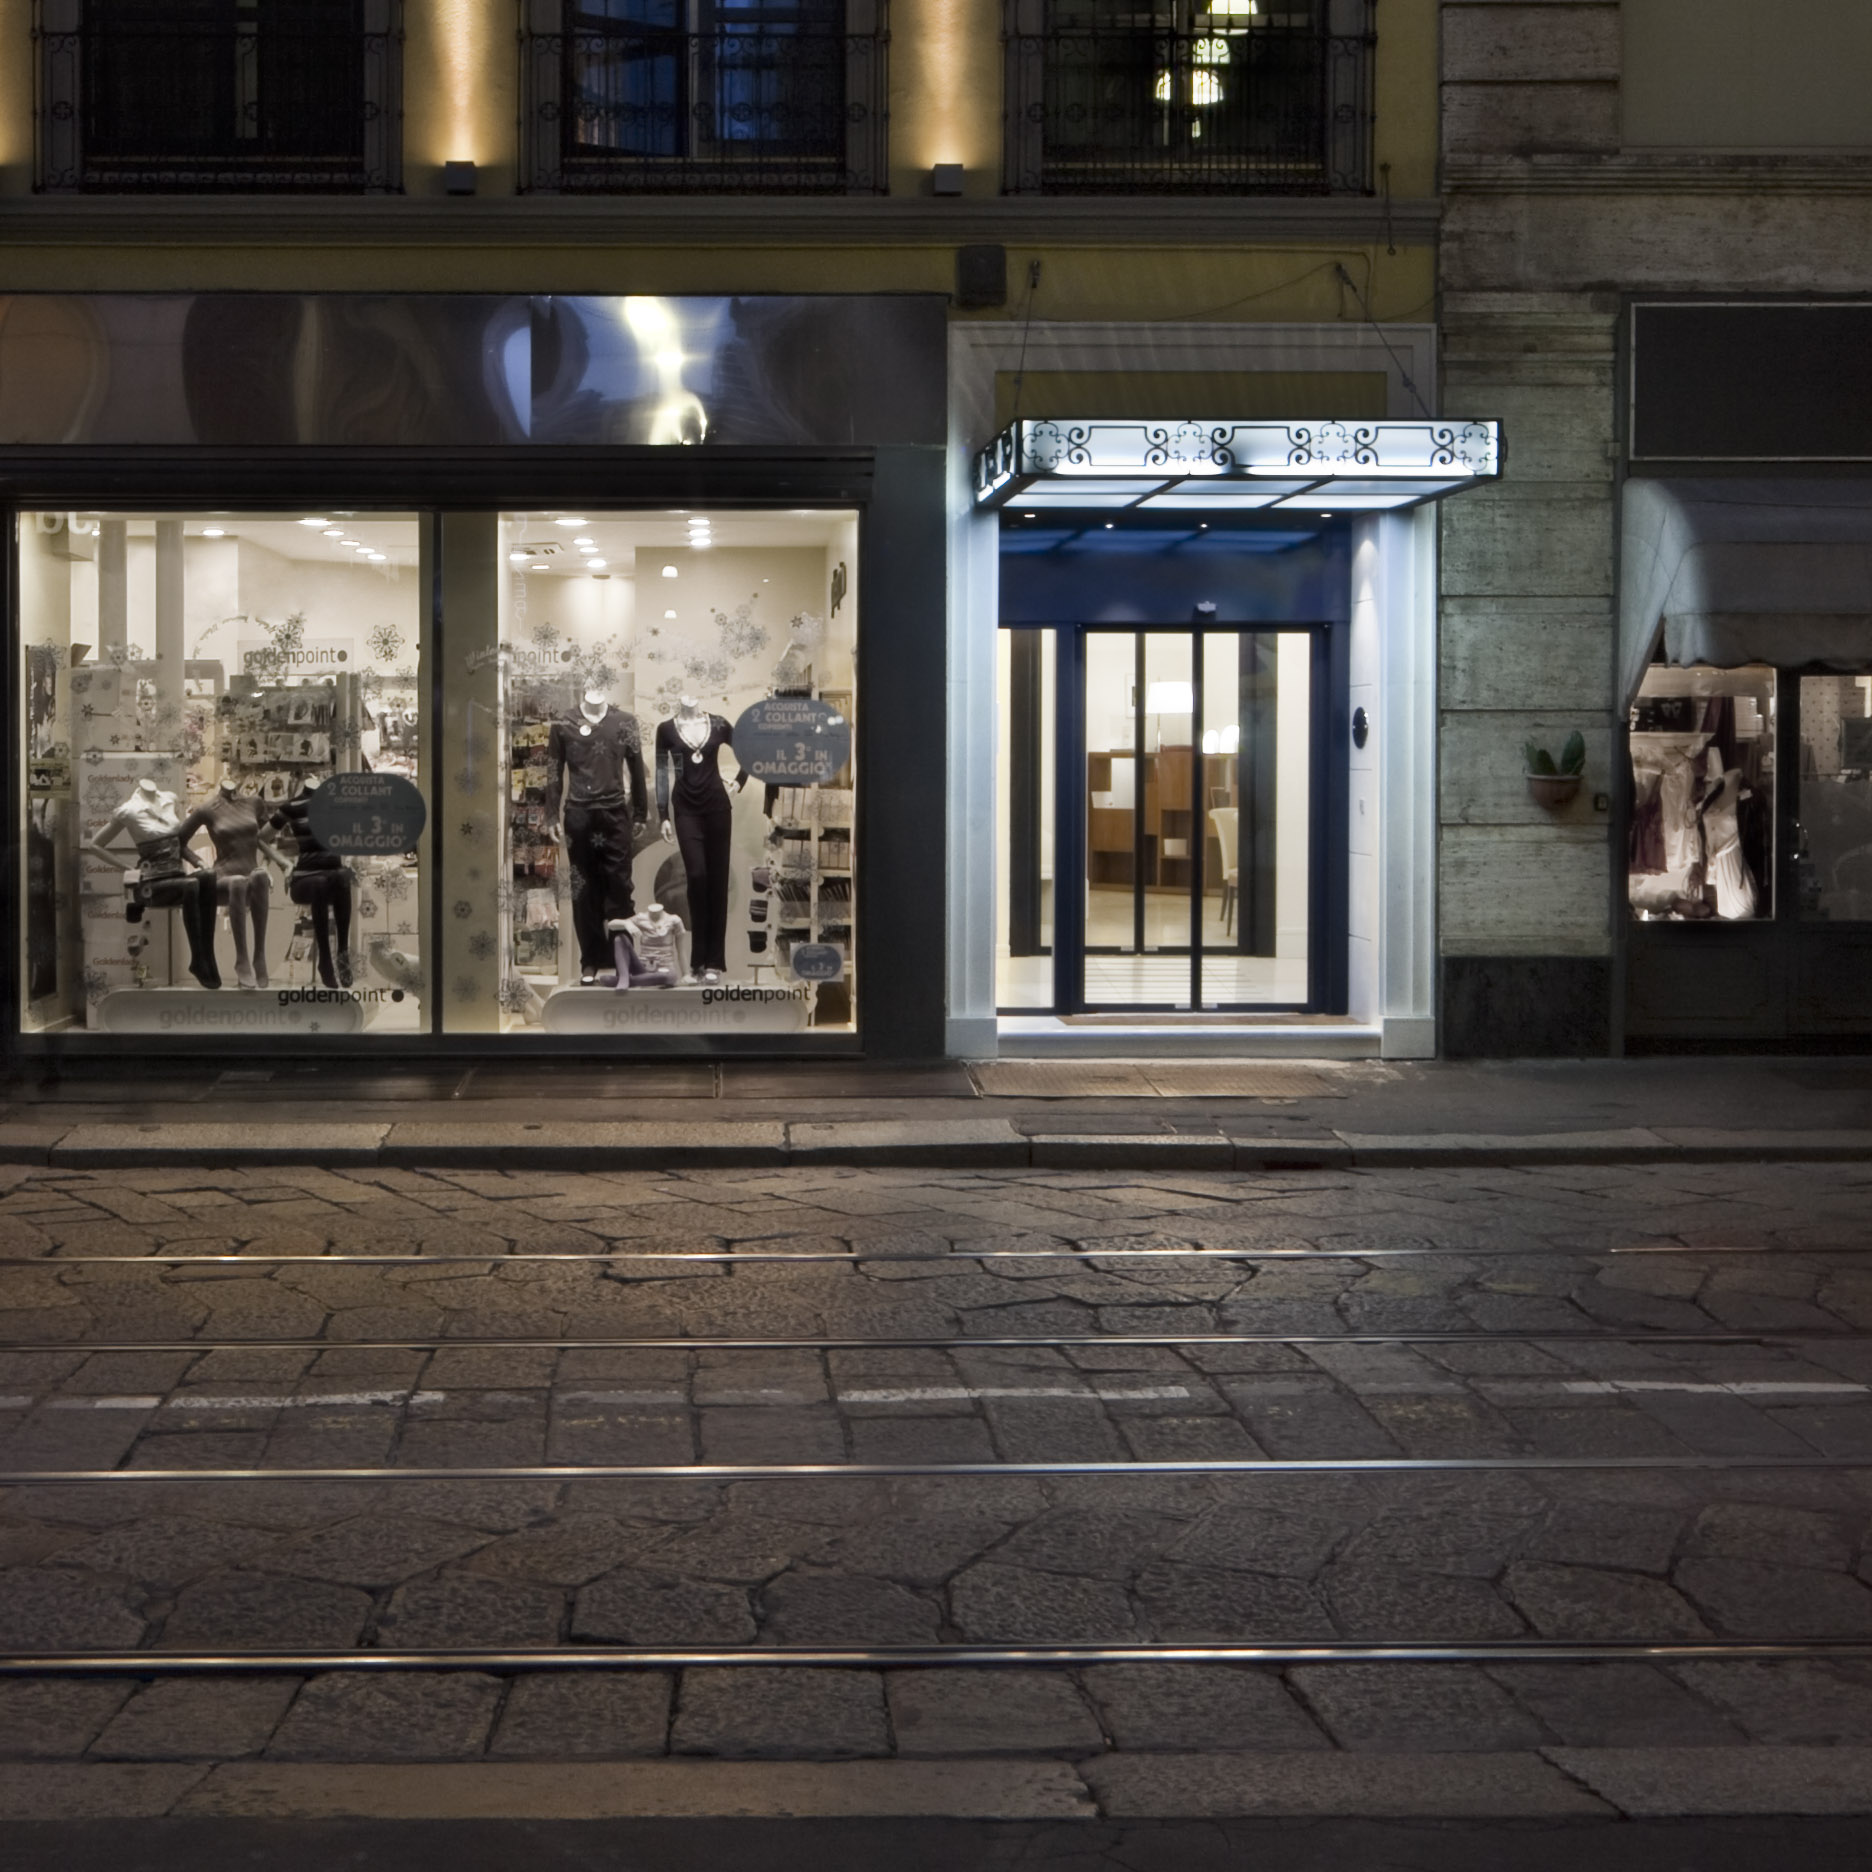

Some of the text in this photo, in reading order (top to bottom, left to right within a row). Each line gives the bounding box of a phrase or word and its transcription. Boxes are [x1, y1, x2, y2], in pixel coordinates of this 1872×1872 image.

[764, 702, 810, 712] ACQUISTA
[751, 708, 816, 723] 2 COLLANT
[776, 749, 786, 761] IL
[815, 749, 828, 761] IN
[340, 776, 385, 785] ACQUISTA
[327, 782, 393, 796] 2 COLLANT
[352, 822, 362, 834] IL
[391, 822, 404, 834] IN
[278, 986, 387, 1006] goldenpoint
[702, 985, 811, 1004] goldenpoint
[159, 1005, 288, 1028] goldenpoint
[602, 1006, 729, 1029] goldenpoint
